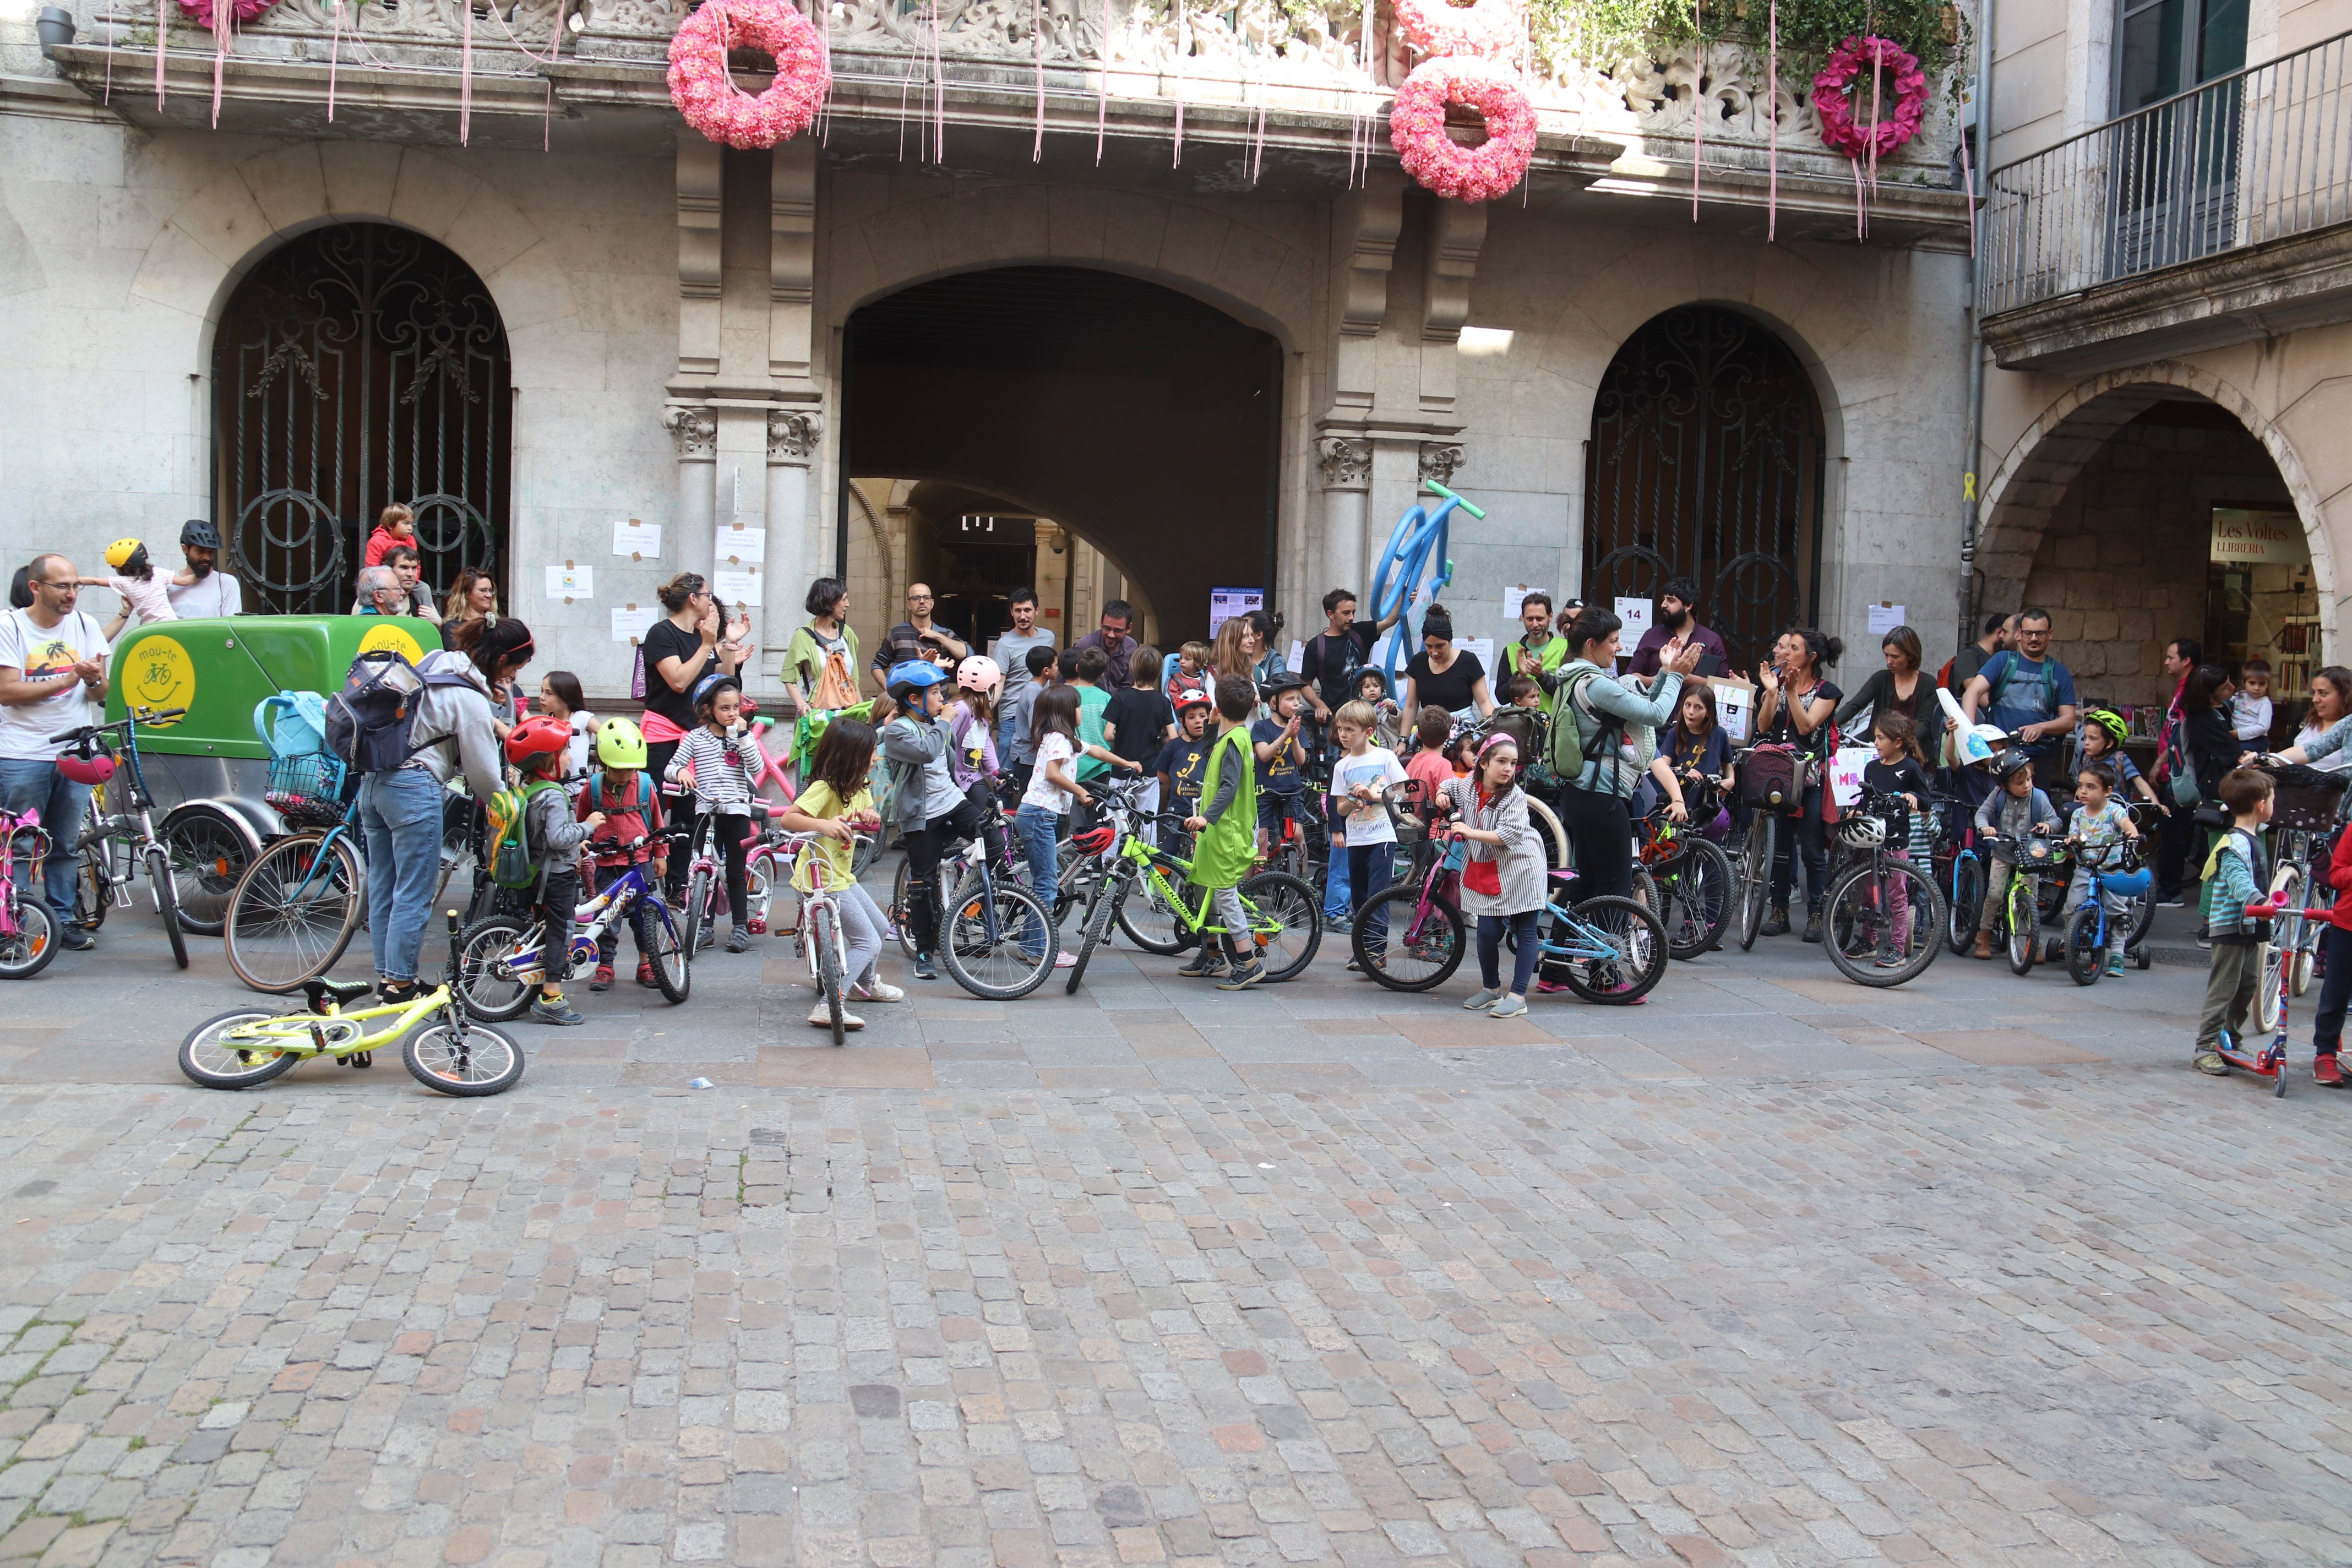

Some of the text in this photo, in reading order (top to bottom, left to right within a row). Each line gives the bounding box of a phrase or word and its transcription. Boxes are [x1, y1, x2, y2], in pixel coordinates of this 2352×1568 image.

[2218, 520, 2289, 541] Les Voltes
[2217, 541, 2264, 554] LLIBRERIA
[1627, 609, 1641, 619] 14
[139, 647, 177, 662] mou-te
[1368, 822, 1390, 831] WAVES
[1156, 874, 1195, 922] ROCKRIDER
